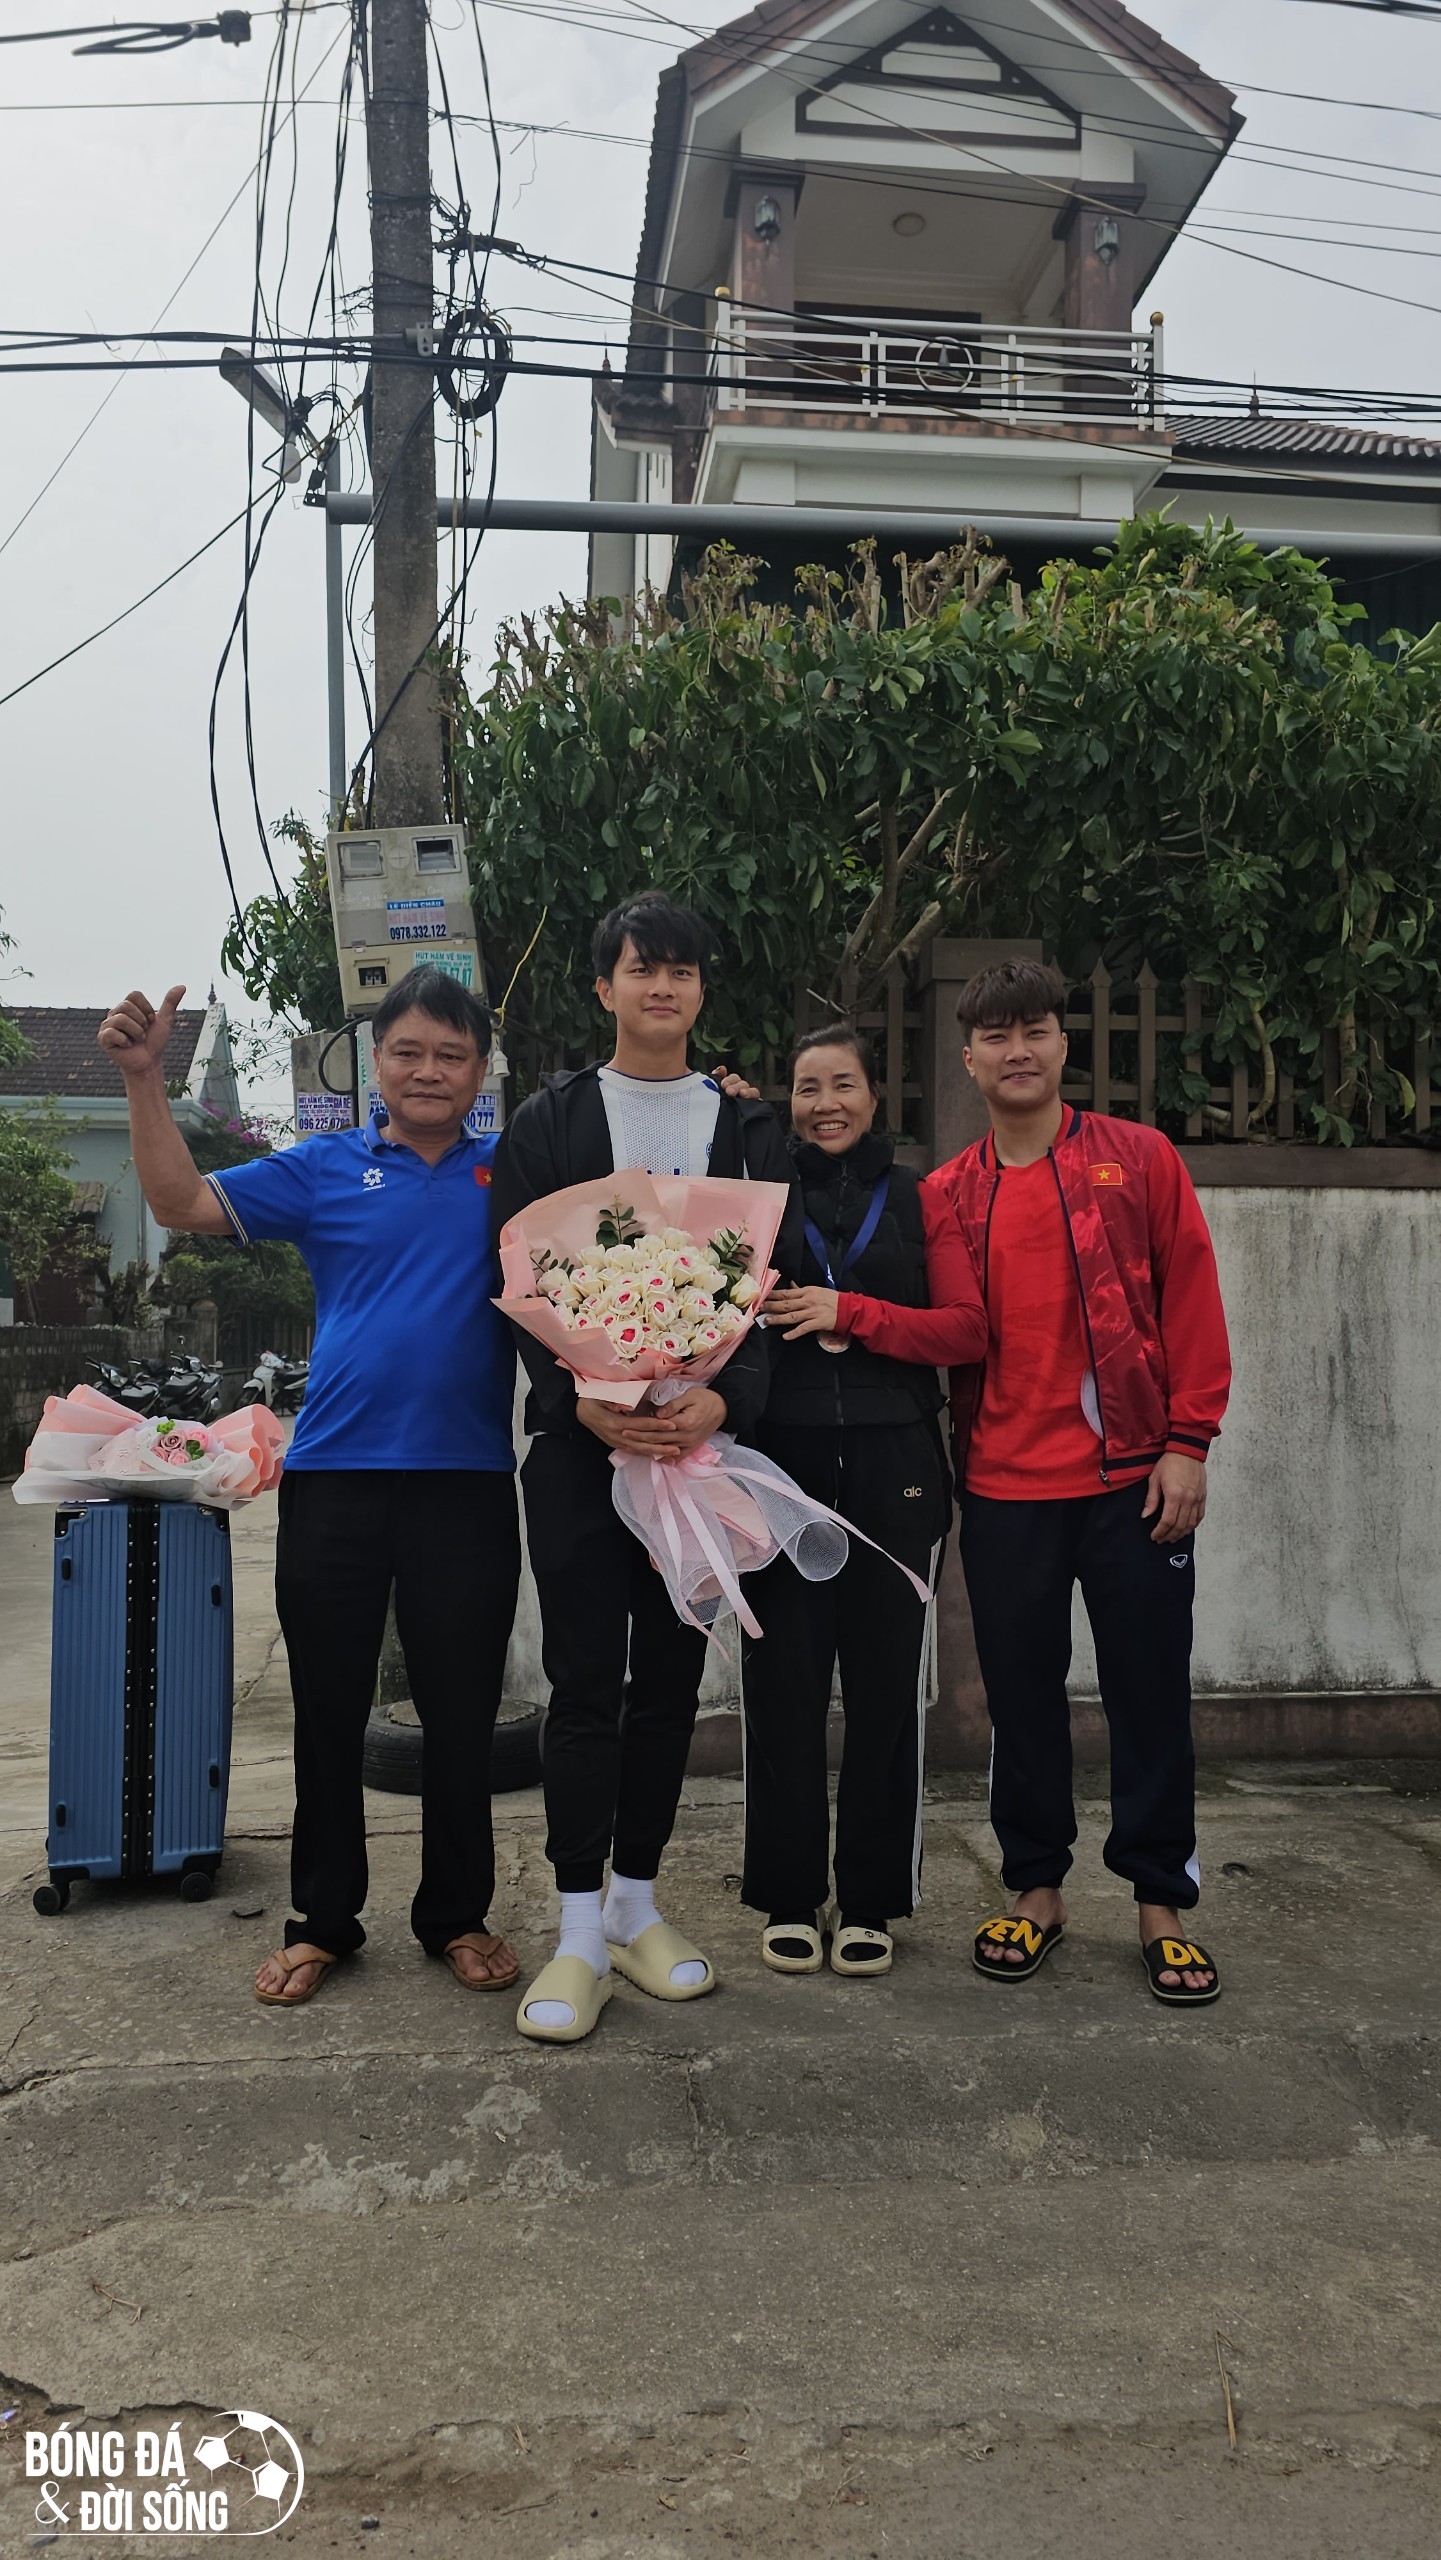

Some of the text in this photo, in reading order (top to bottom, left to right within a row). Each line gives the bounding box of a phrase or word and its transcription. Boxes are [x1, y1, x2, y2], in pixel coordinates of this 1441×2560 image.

[390, 924, 447, 940] 0978.332.122
[456, 953, 472, 961] SINH
[299, 1118, 315, 1130] 096
[477, 1111, 495, 1128] 777
